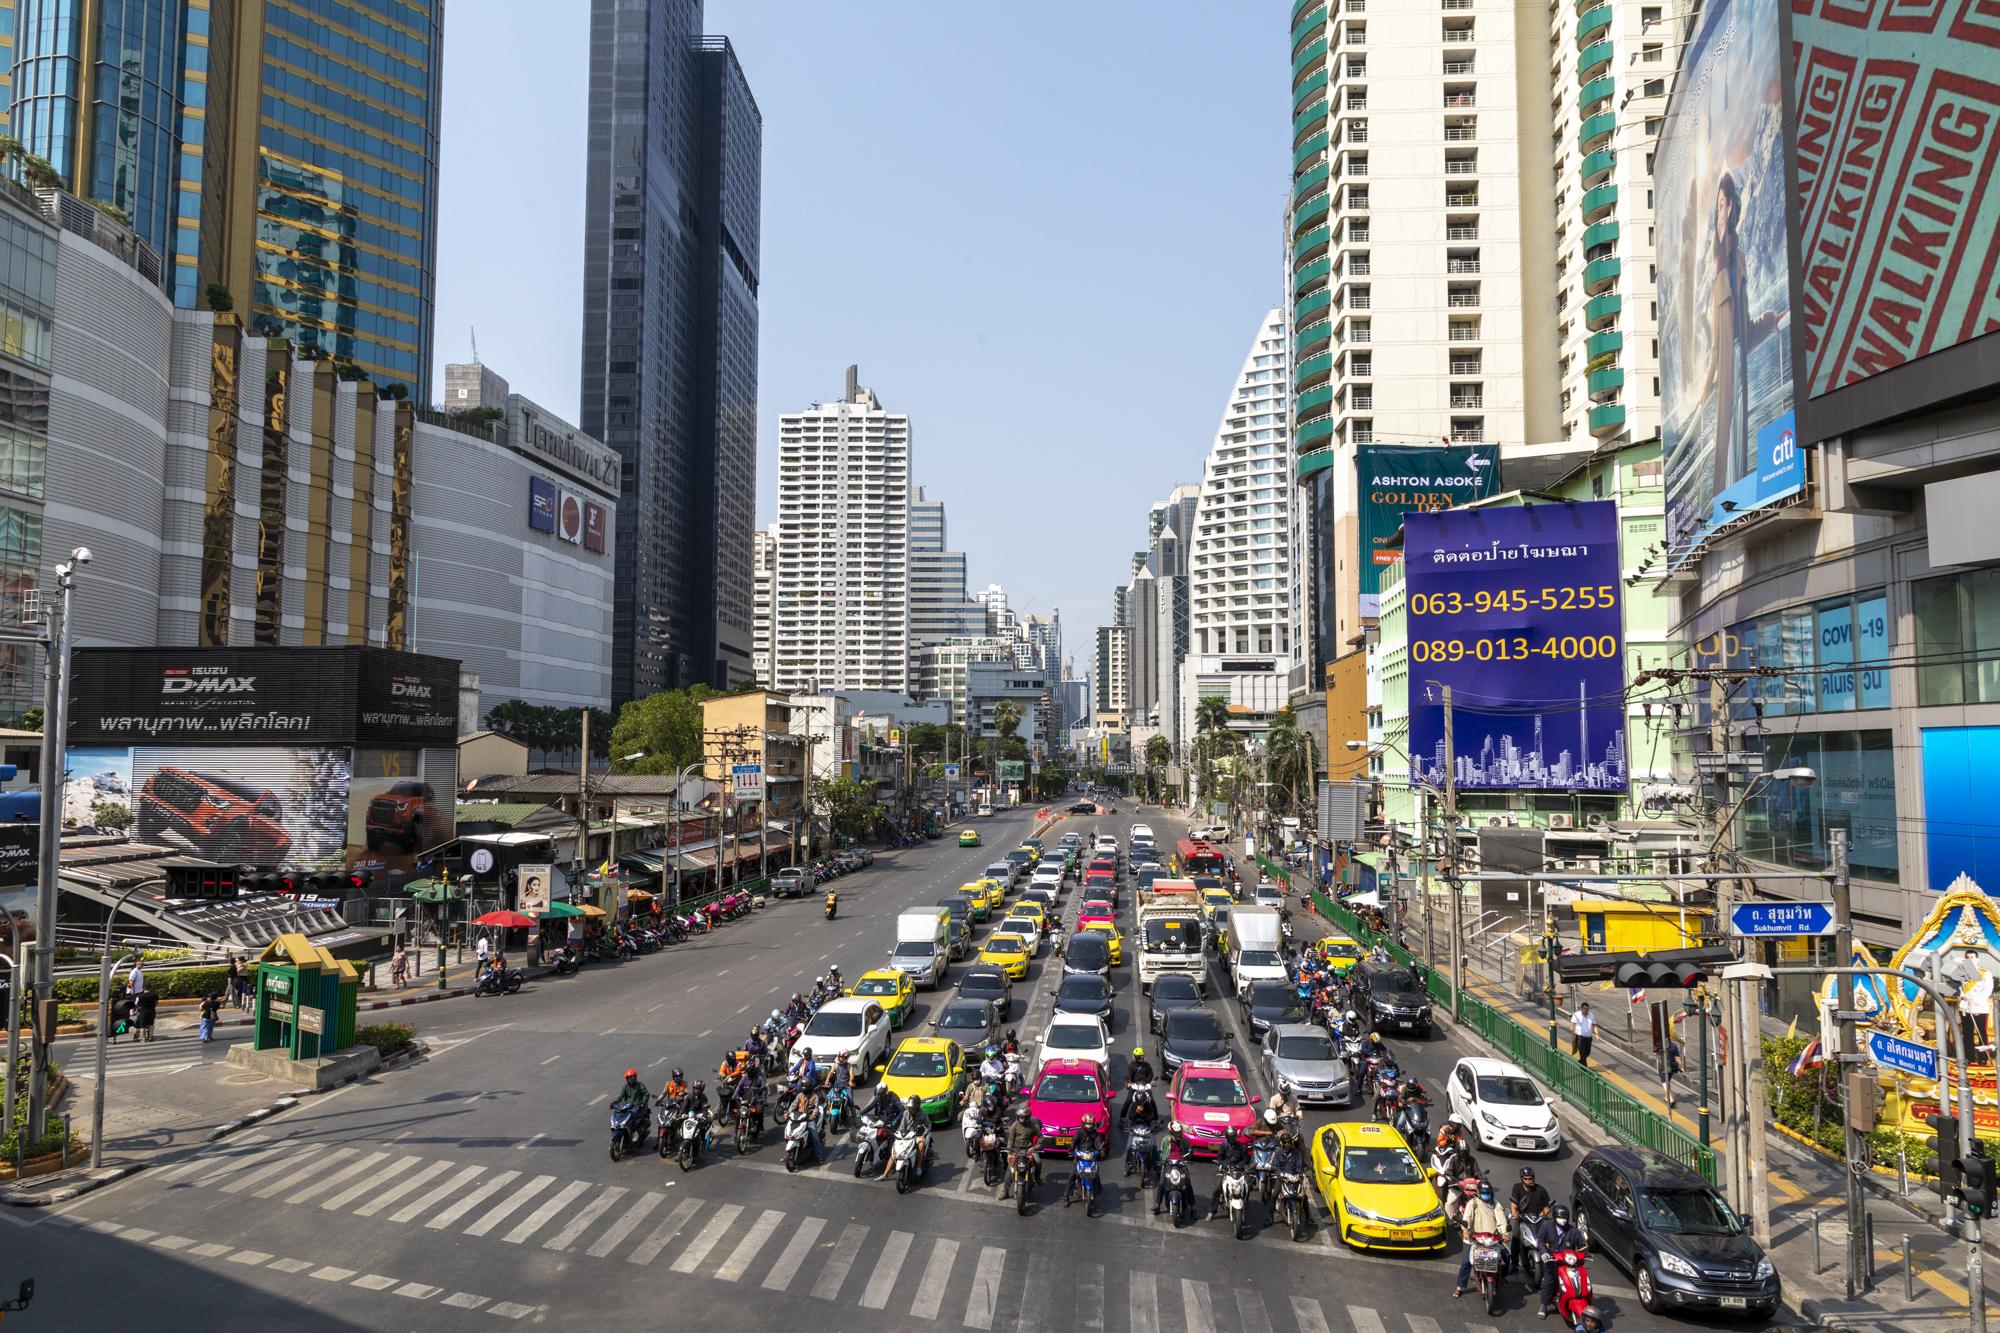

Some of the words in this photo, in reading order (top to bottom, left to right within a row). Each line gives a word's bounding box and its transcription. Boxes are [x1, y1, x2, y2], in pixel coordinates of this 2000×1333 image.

[1773, 434, 1794, 466] citi
[1372, 476, 1429, 486] ASHTON
[1434, 477, 1482, 486] ASOKE
[1371, 492, 1454, 508] GOLDEN
[1411, 586, 1615, 615] 063-945-5255
[1822, 617, 1884, 647] COVI-19
[1412, 635, 1617, 662] 089-013-4000
[192, 667, 228, 675] ISUZU
[382, 752, 401, 777] VS
[1752, 910, 1763, 921] ถ.
[1768, 905, 1812, 924] สุขุมวิท
[1753, 924, 1793, 932] Sukhumvit
[1799, 923, 1812, 931] Rd.
[1877, 1040, 1885, 1051] ถ.
[1883, 1055, 1896, 1064] Asok
[1898, 1059, 1916, 1070] Montri
[1917, 1065, 1929, 1074] Rd.
